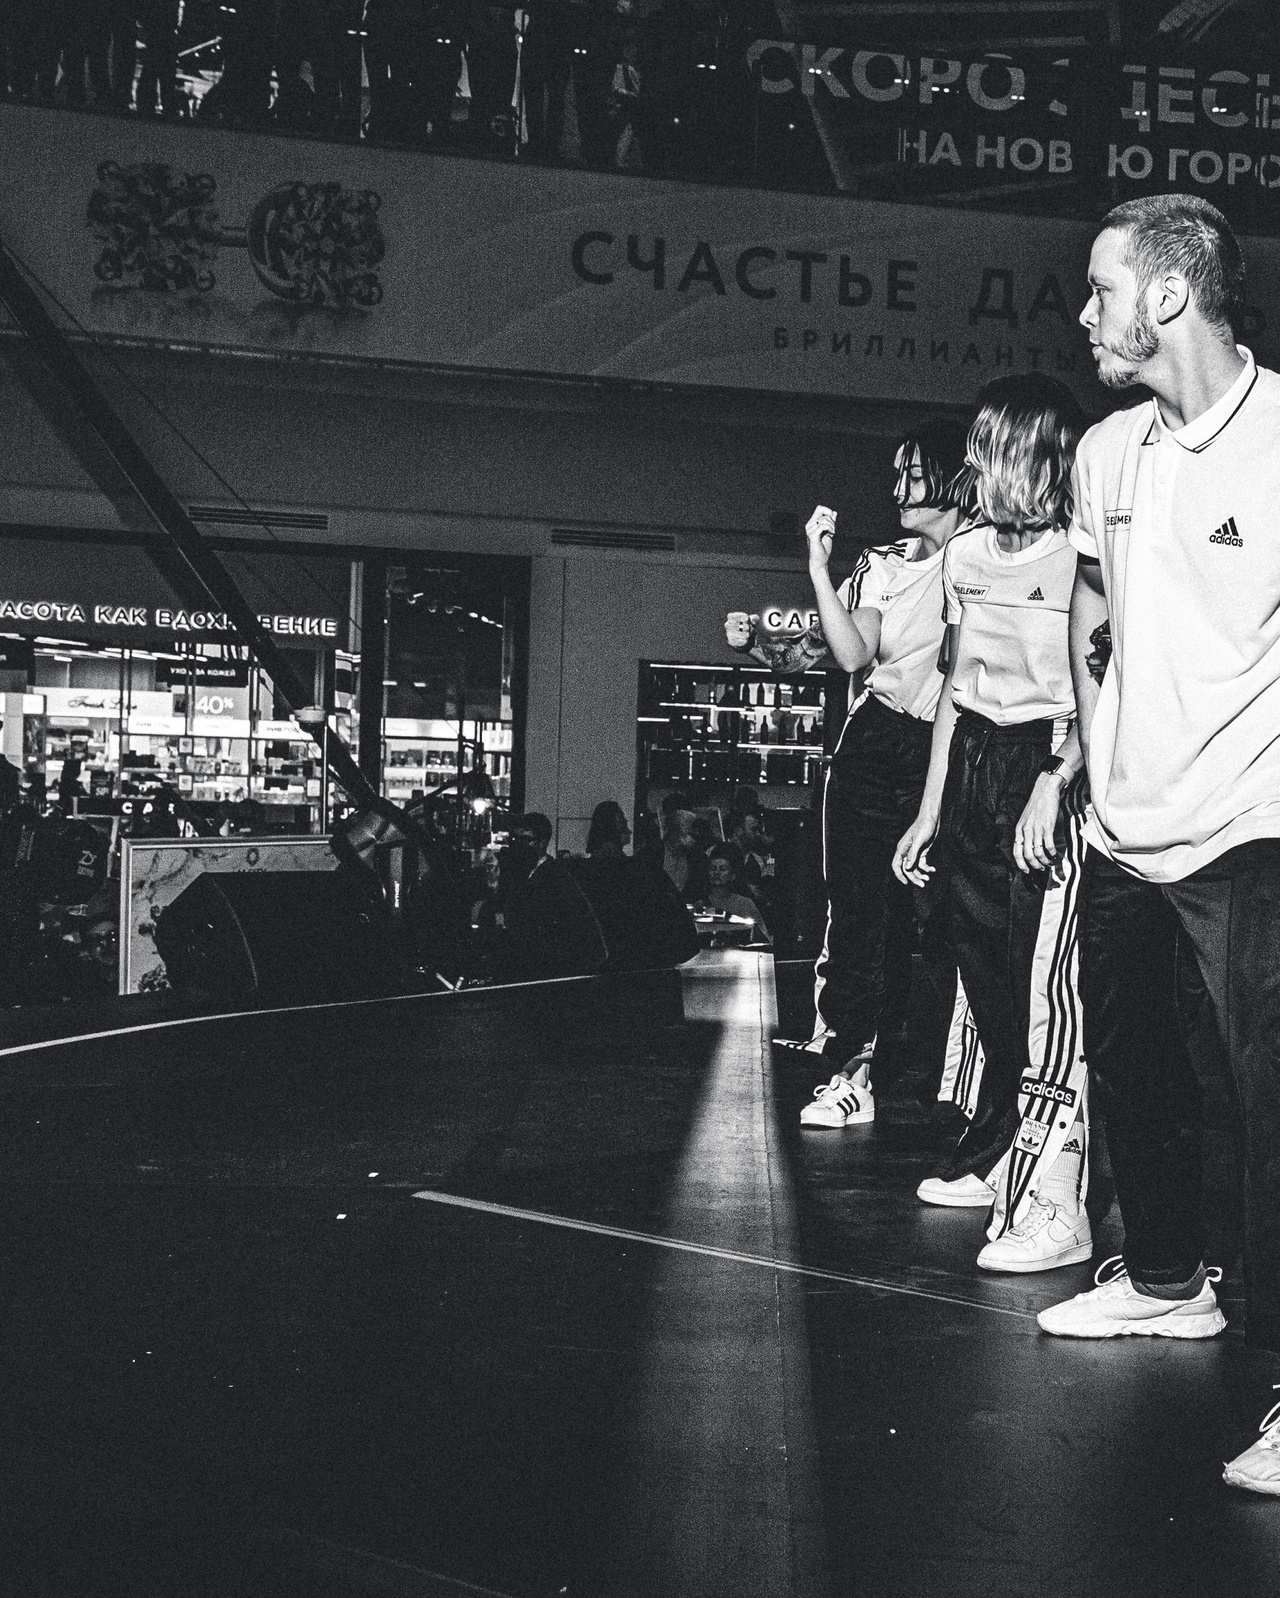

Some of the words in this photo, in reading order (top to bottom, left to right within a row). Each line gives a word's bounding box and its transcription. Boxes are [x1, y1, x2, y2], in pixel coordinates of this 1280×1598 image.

[746, 38, 1026, 111] СКОРО
[897, 128, 962, 166] НА
[976, 135, 1154, 181] НОВЮ
[570, 230, 918, 312] СЧАСТЬЕ
[1209, 533, 1244, 547] adidas
[0, 600, 86, 623] АСОТА
[94, 605, 146, 627] КАК
[155, 608, 338, 637] ВДОХВЕНИЕ
[1021, 1081, 1073, 1104] adidas
